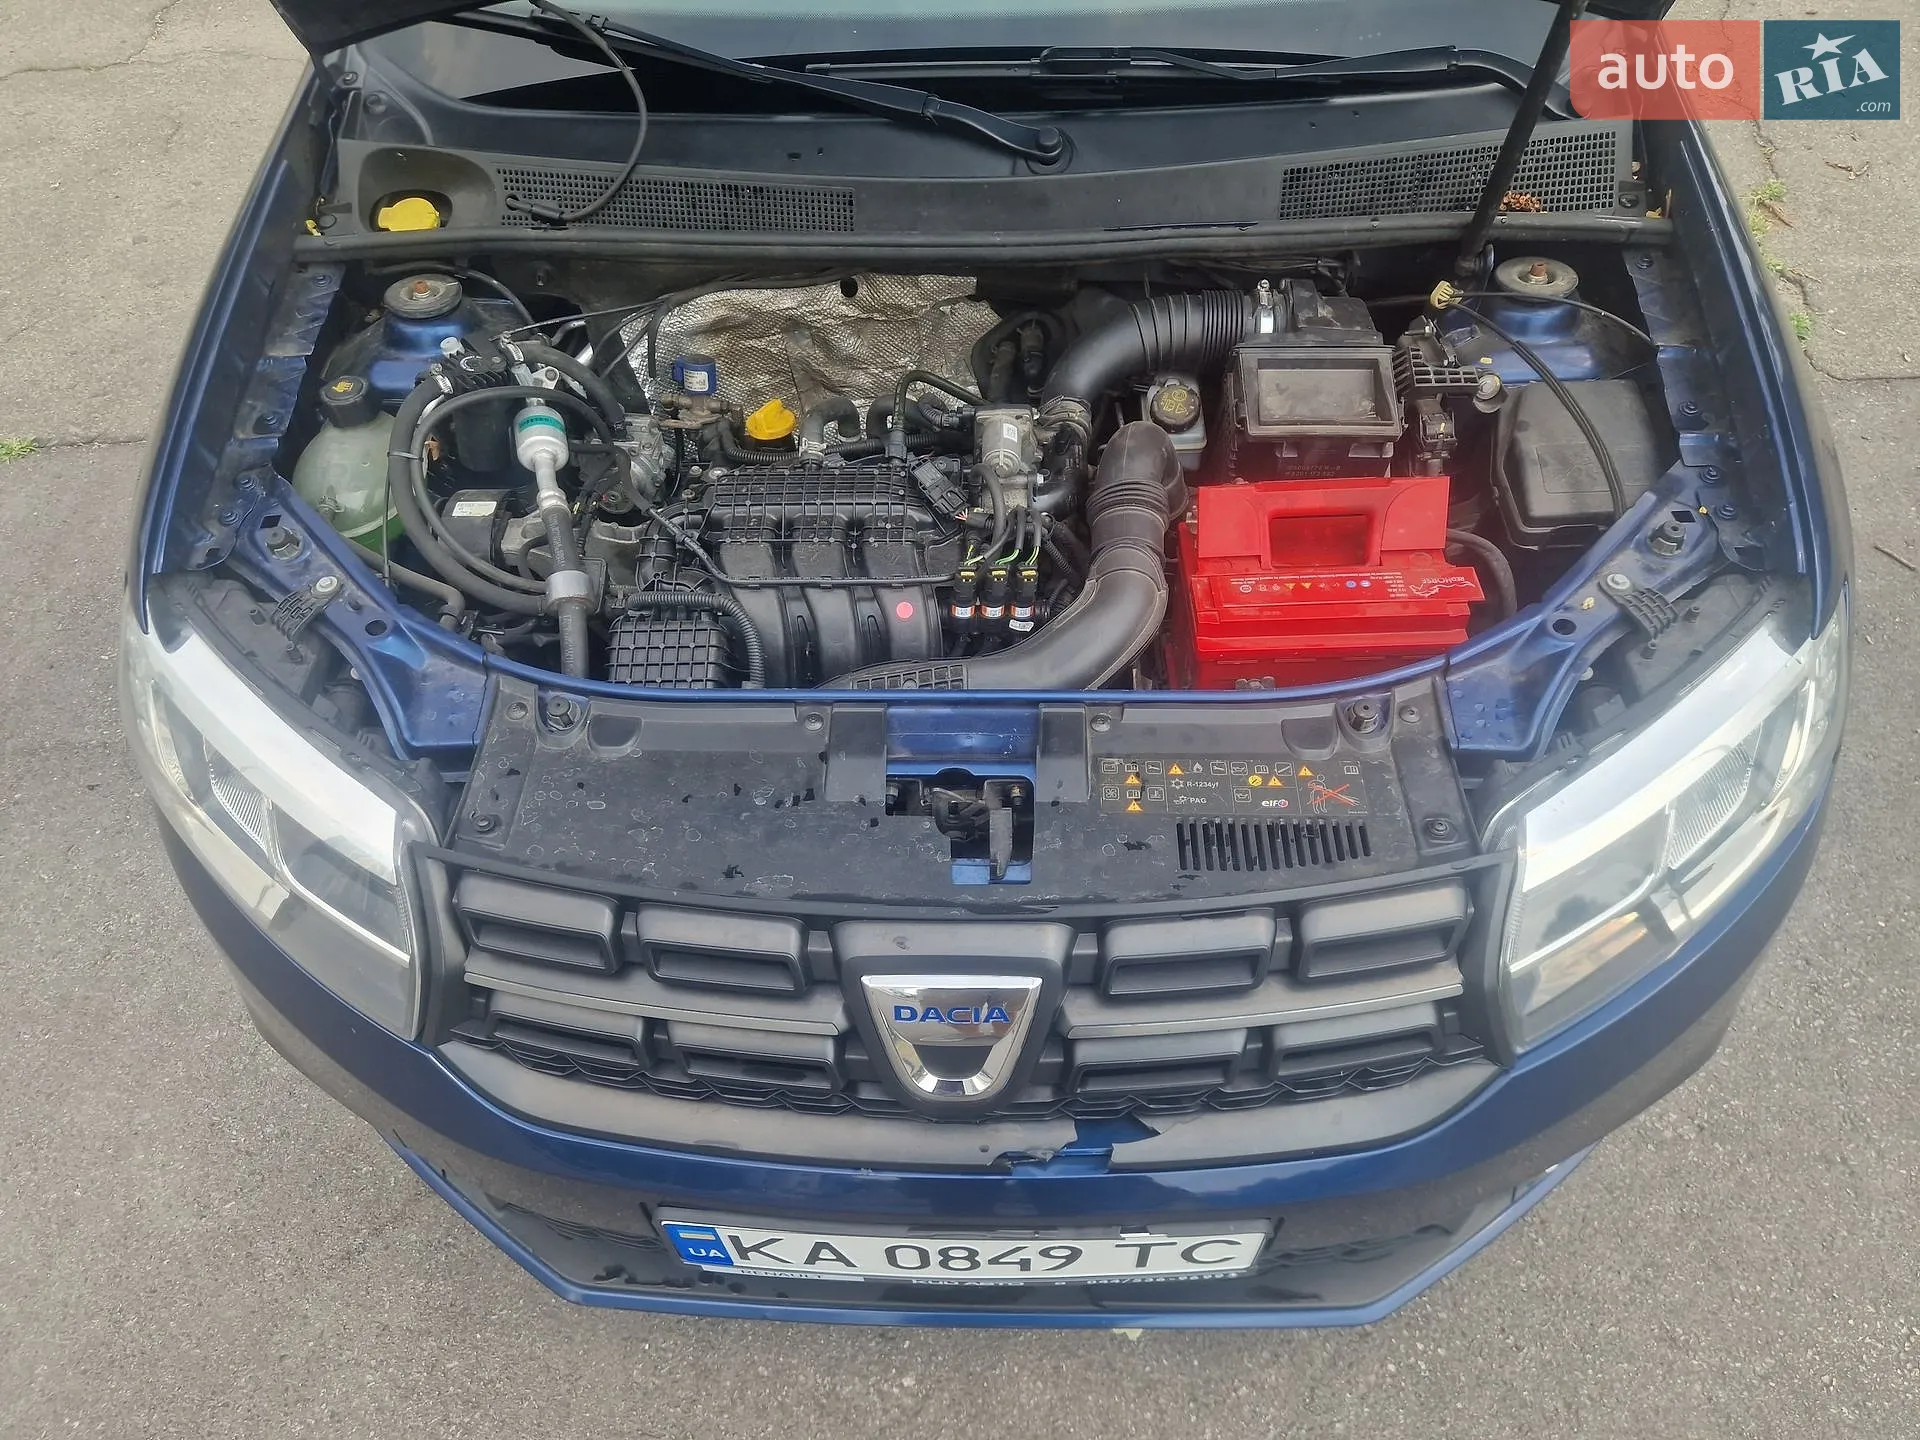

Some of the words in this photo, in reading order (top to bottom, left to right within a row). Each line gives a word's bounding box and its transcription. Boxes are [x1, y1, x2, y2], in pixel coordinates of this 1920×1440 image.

[893, 1005, 1011, 1024] DACIA
[688, 1247, 725, 1258] UA
[727, 1234, 858, 1268] KA
[884, 1244, 1083, 1271] 0849
[1115, 1240, 1245, 1269] TC
